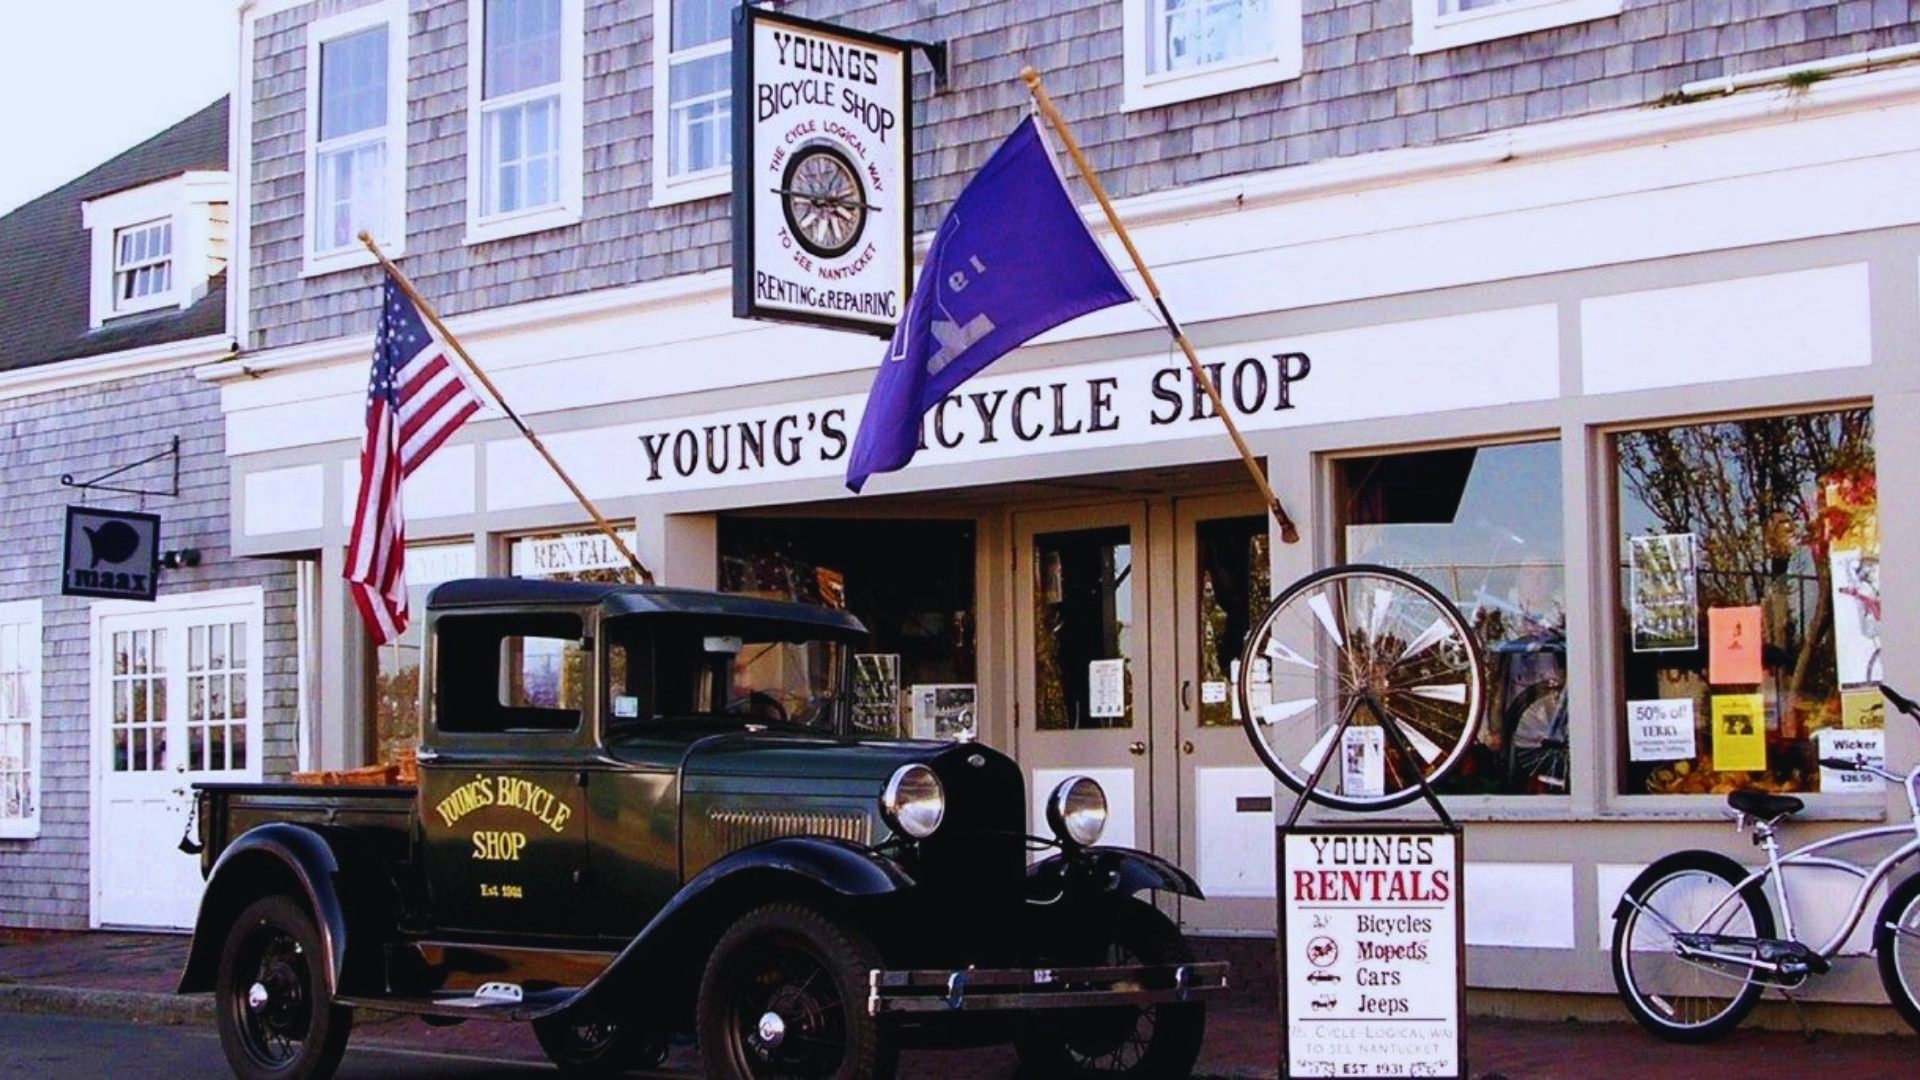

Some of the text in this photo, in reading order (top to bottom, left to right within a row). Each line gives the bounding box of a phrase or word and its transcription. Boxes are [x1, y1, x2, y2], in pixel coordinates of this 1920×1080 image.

[774, 31, 878, 85] YOUNGS
[758, 79, 895, 143] BICYCLE SHOP
[769, 120, 883, 192] THE CYCLE LOGICAL WAY
[777, 226, 876, 280] TO SEE NANTUCKET
[638, 352, 1311, 481] YOUNG'S CYCLE SHOP
[534, 539, 619, 569] RENTAL
[75, 568, 147, 592] maax
[1833, 740, 1877, 750] Wicker
[436, 773, 572, 833] YOUNG'S BICYCLE
[472, 830, 526, 860] SHOP
[1310, 837, 1433, 865] YOUNGS
[1293, 869, 1450, 901] RENTALS
[1357, 914, 1432, 936] Bicycles
[1357, 941, 1428, 963] Mopeds
[1356, 967, 1401, 986] Cars
[1358, 994, 1409, 1016] Jeeps
[1306, 1043, 1323, 1054] TO
[1376, 1063, 1403, 1074] 1931
